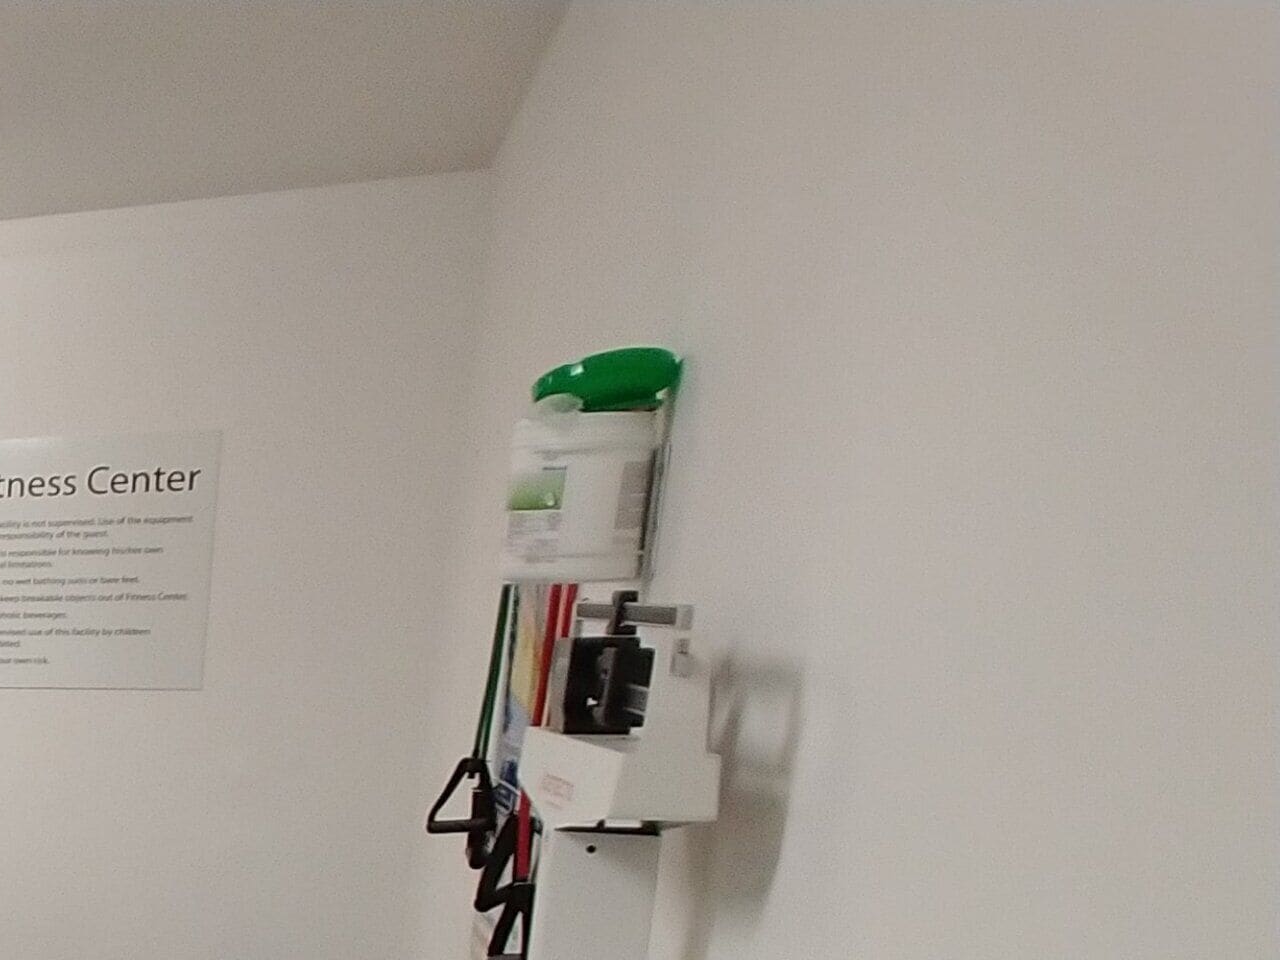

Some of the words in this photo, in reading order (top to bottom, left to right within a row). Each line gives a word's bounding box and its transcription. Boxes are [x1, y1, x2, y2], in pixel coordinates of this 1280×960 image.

[87, 466, 202, 496] Center
[31, 520, 46, 528] not
[116, 516, 126, 526] of
[127, 516, 141, 525] the
[55, 530, 65, 539] of
[66, 530, 81, 538] the
